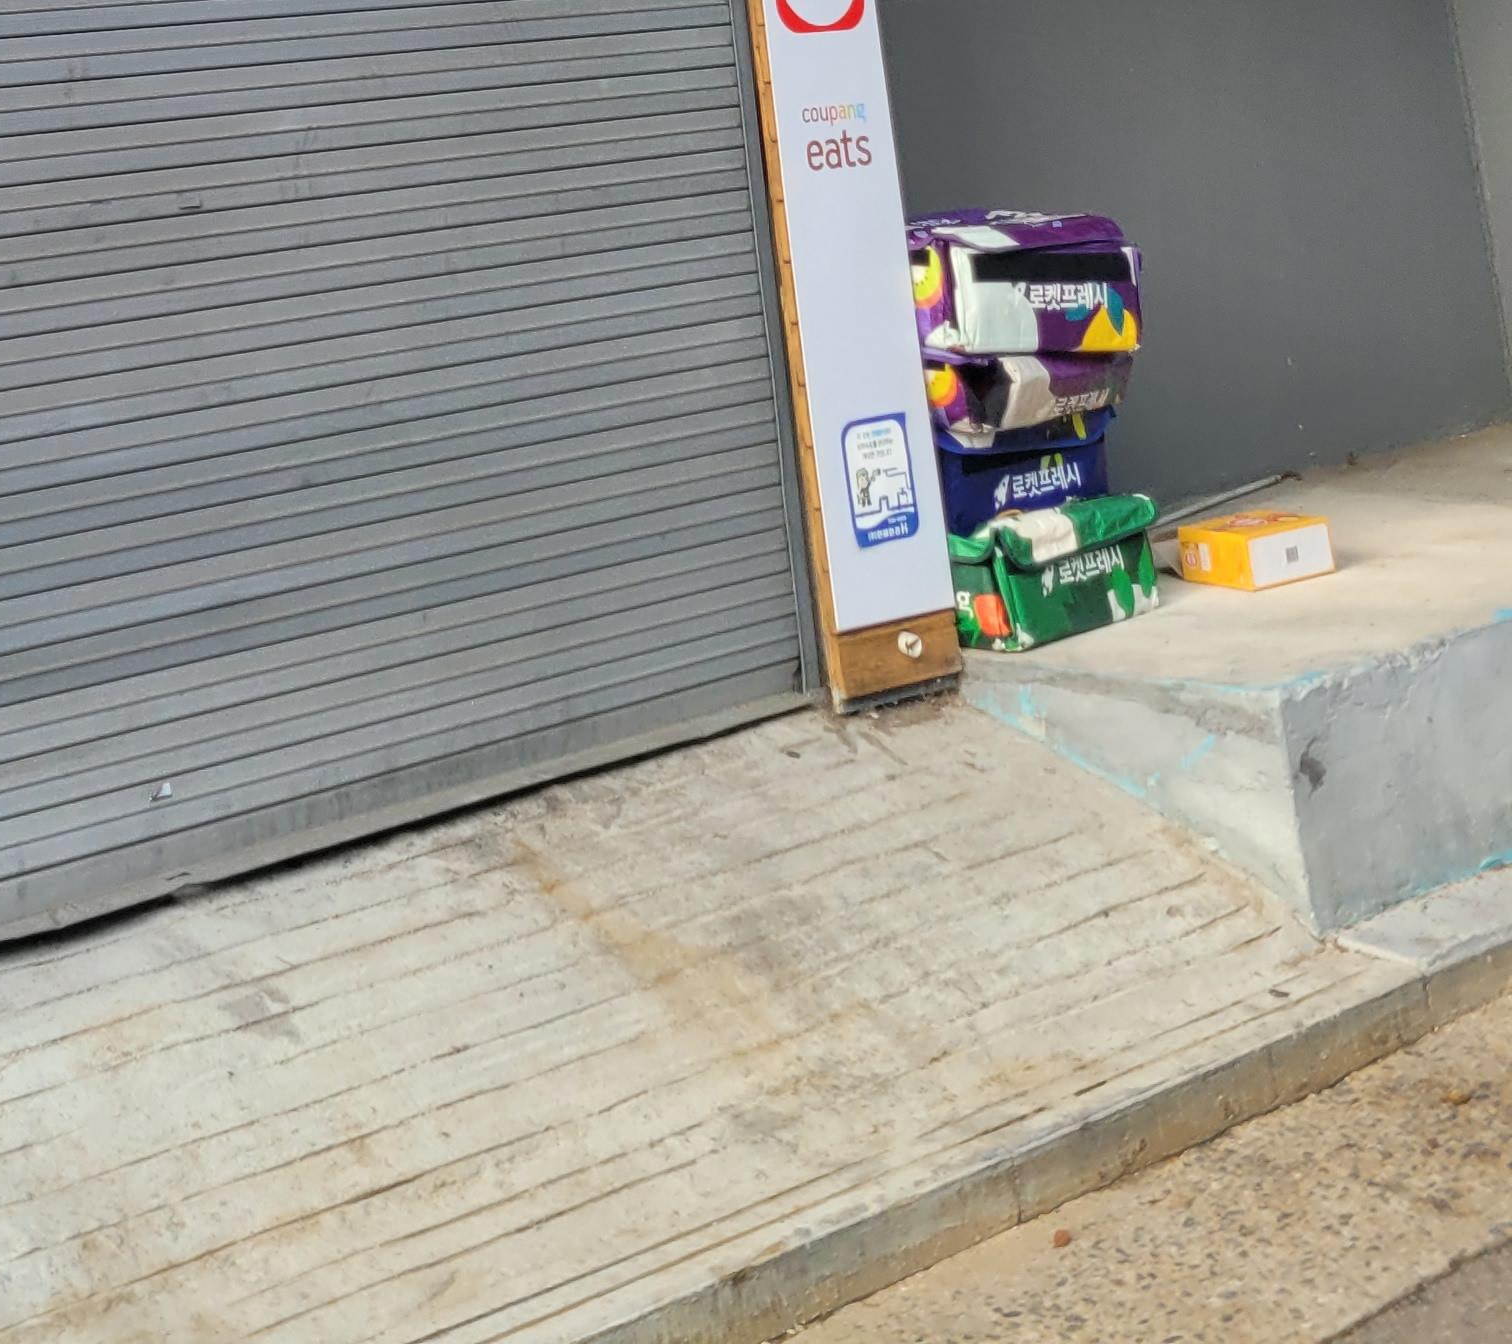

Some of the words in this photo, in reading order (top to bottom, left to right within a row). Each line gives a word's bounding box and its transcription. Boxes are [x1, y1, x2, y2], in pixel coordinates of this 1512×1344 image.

[802, 103, 867, 127] coupang
[806, 129, 873, 171] eats
[1029, 282, 1108, 311] 로켓프레시
[1012, 462, 1082, 499] 로켓프레시
